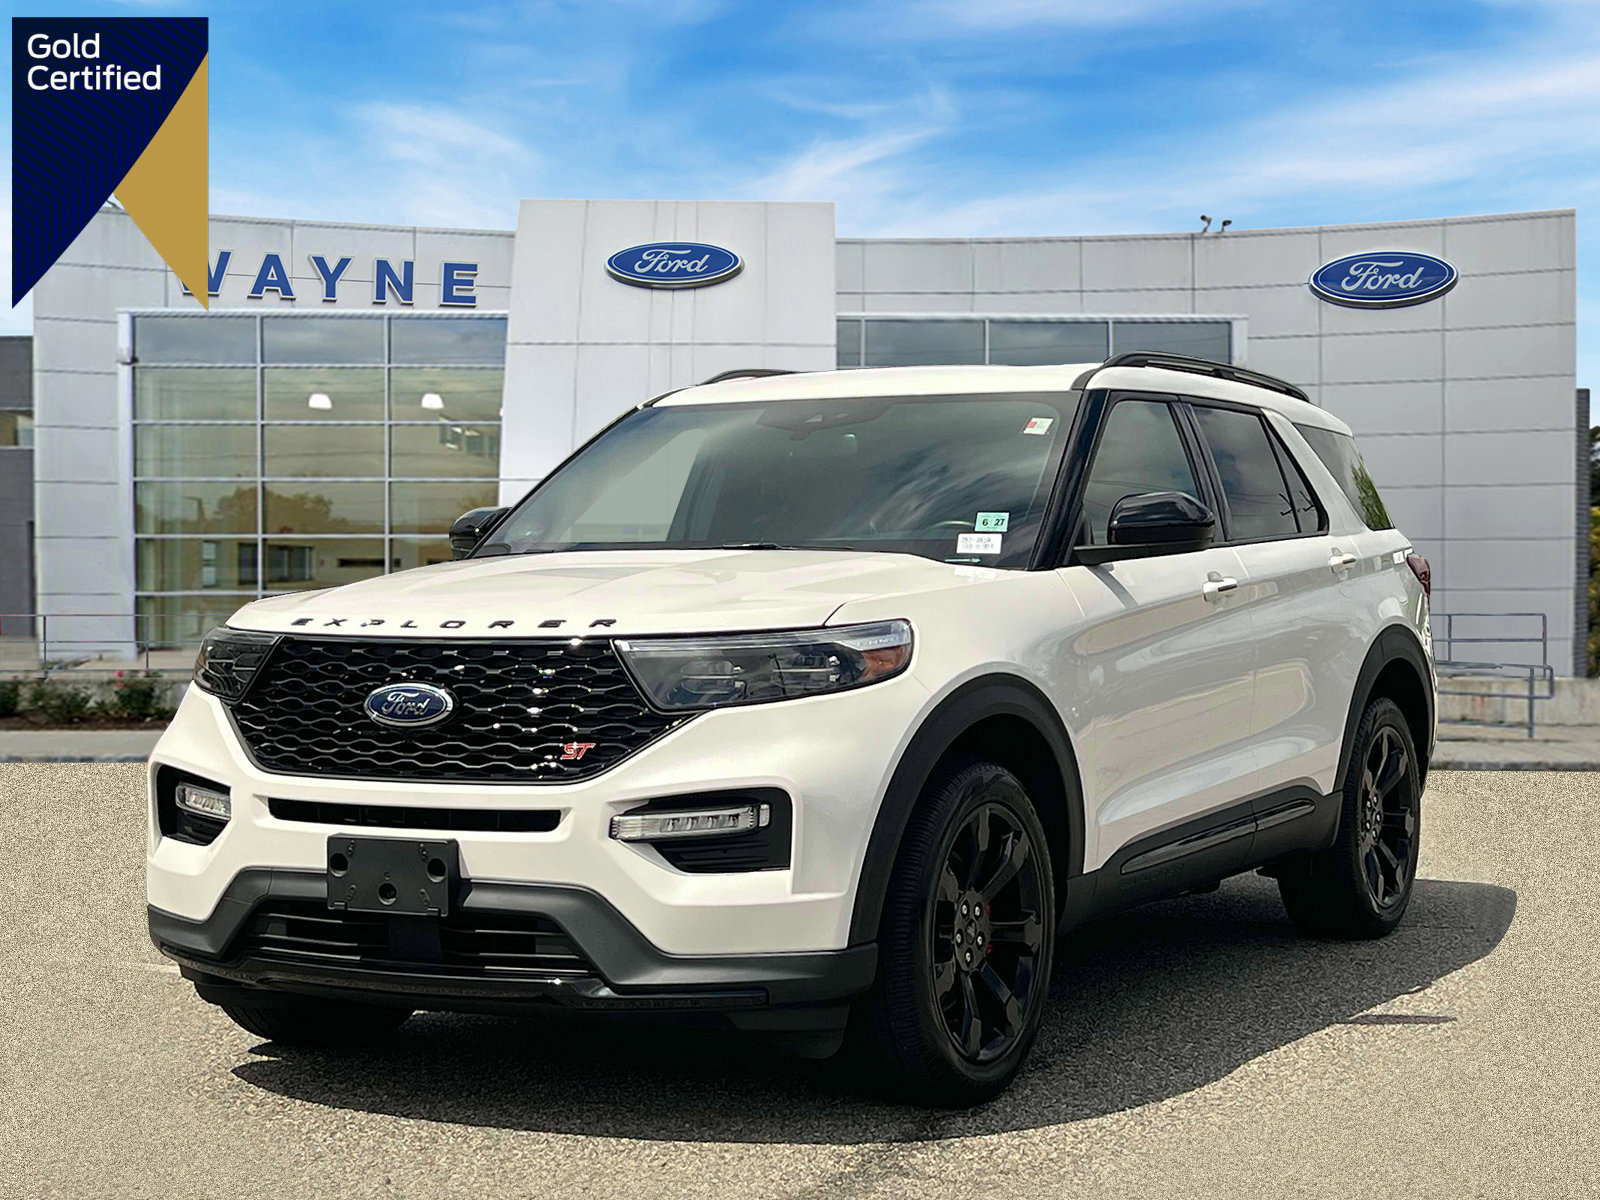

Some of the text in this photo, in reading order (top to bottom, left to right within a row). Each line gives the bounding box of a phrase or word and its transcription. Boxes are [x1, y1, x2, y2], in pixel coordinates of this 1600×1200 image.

[633, 248, 711, 274] Ford
[1341, 261, 1424, 291] Ford
[982, 518, 1005, 527] 6 27
[290, 617, 617, 630] EXPLORER
[381, 691, 431, 715] Ford
[560, 742, 596, 760] ST
